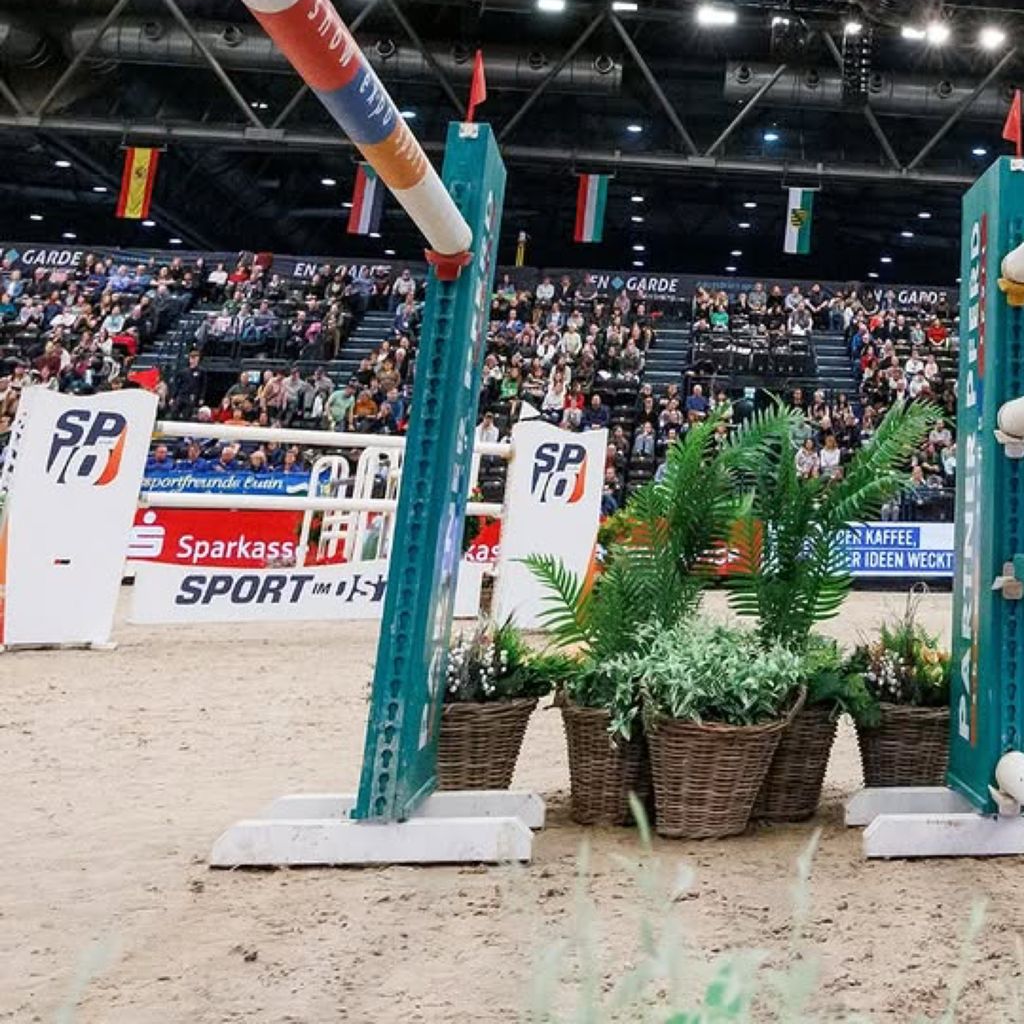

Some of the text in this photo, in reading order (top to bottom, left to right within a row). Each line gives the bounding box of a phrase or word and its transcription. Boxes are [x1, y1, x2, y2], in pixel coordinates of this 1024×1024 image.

[22, 249, 83, 266] GARDE
[294, 263, 316, 277] EN
[626, 277, 679, 292] GARDE
[866, 530, 917, 548] KAFFEE,
[864, 552, 904, 568] IDEEN
[908, 553, 954, 568] WECKT
[175, 575, 315, 606] SPORT
[311, 581, 332, 595] IM
